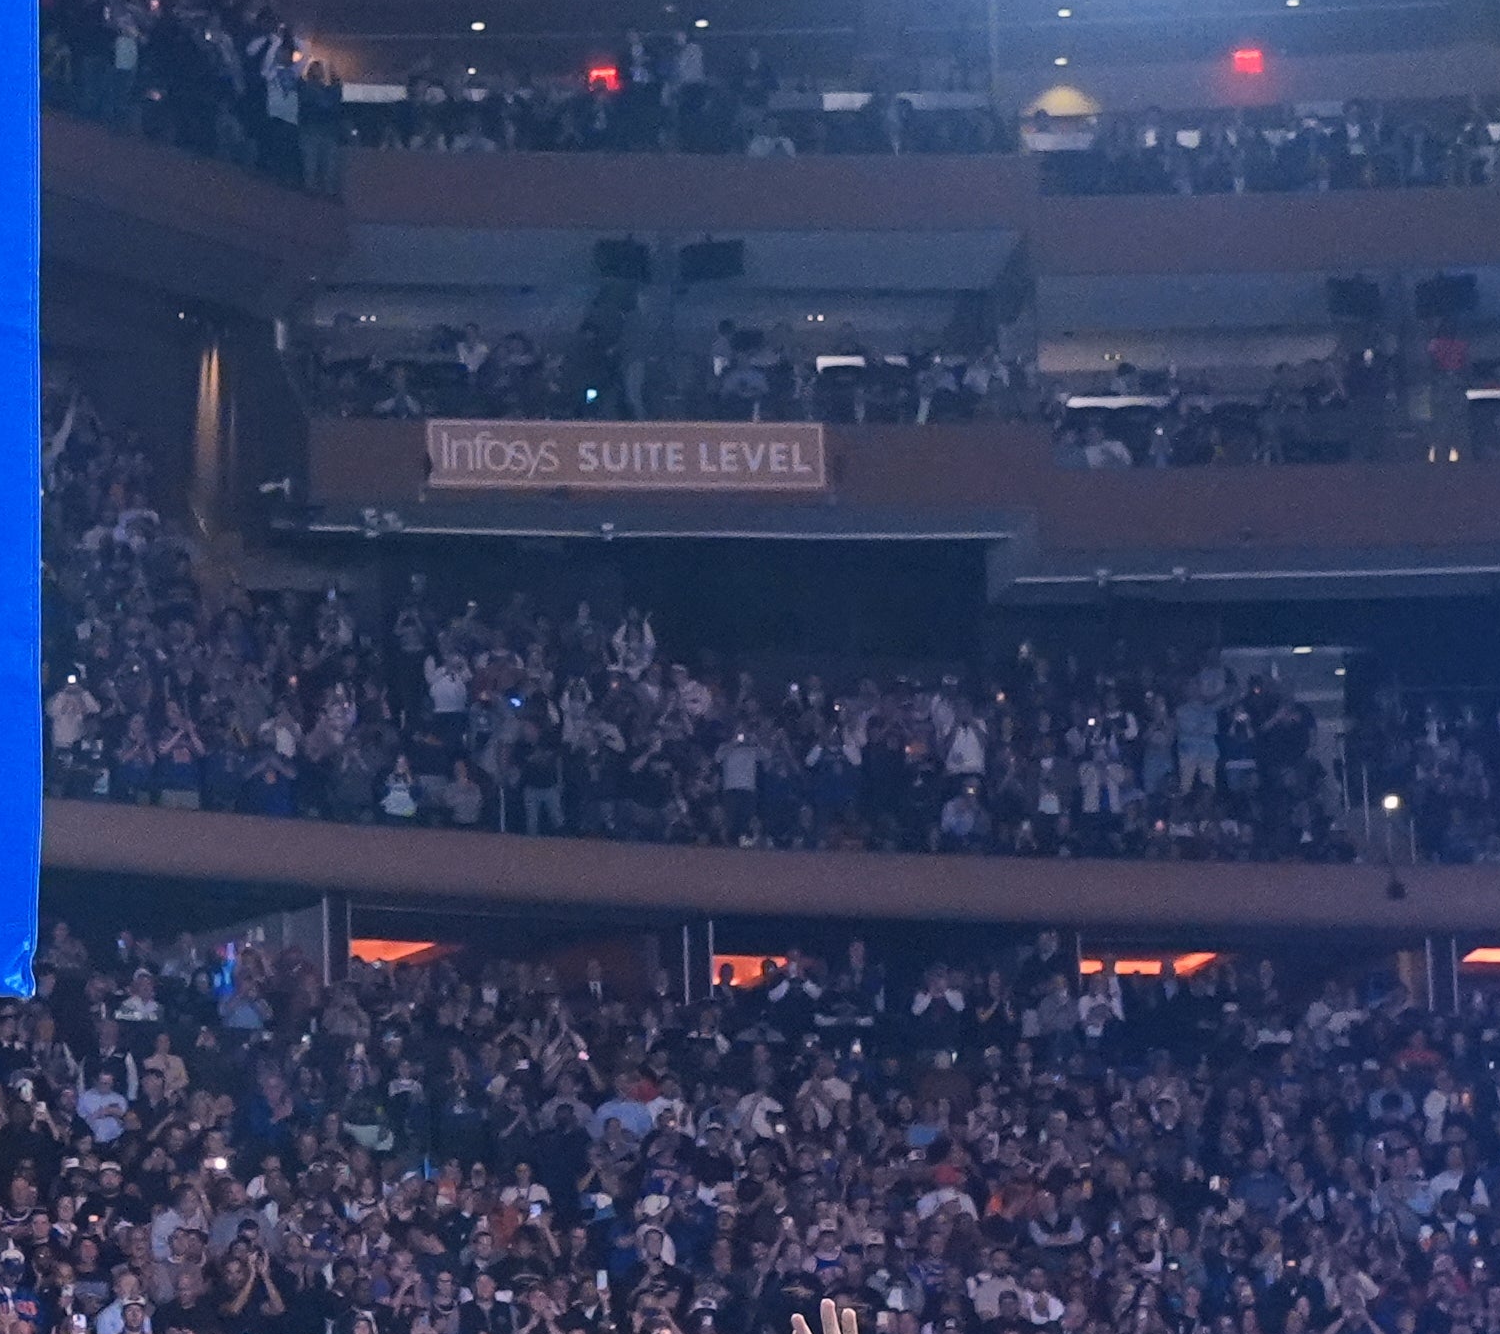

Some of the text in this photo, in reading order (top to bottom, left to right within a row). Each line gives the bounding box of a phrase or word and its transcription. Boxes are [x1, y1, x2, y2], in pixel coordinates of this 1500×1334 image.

[441, 431, 813, 479] Infosys SUITE LEVEL
